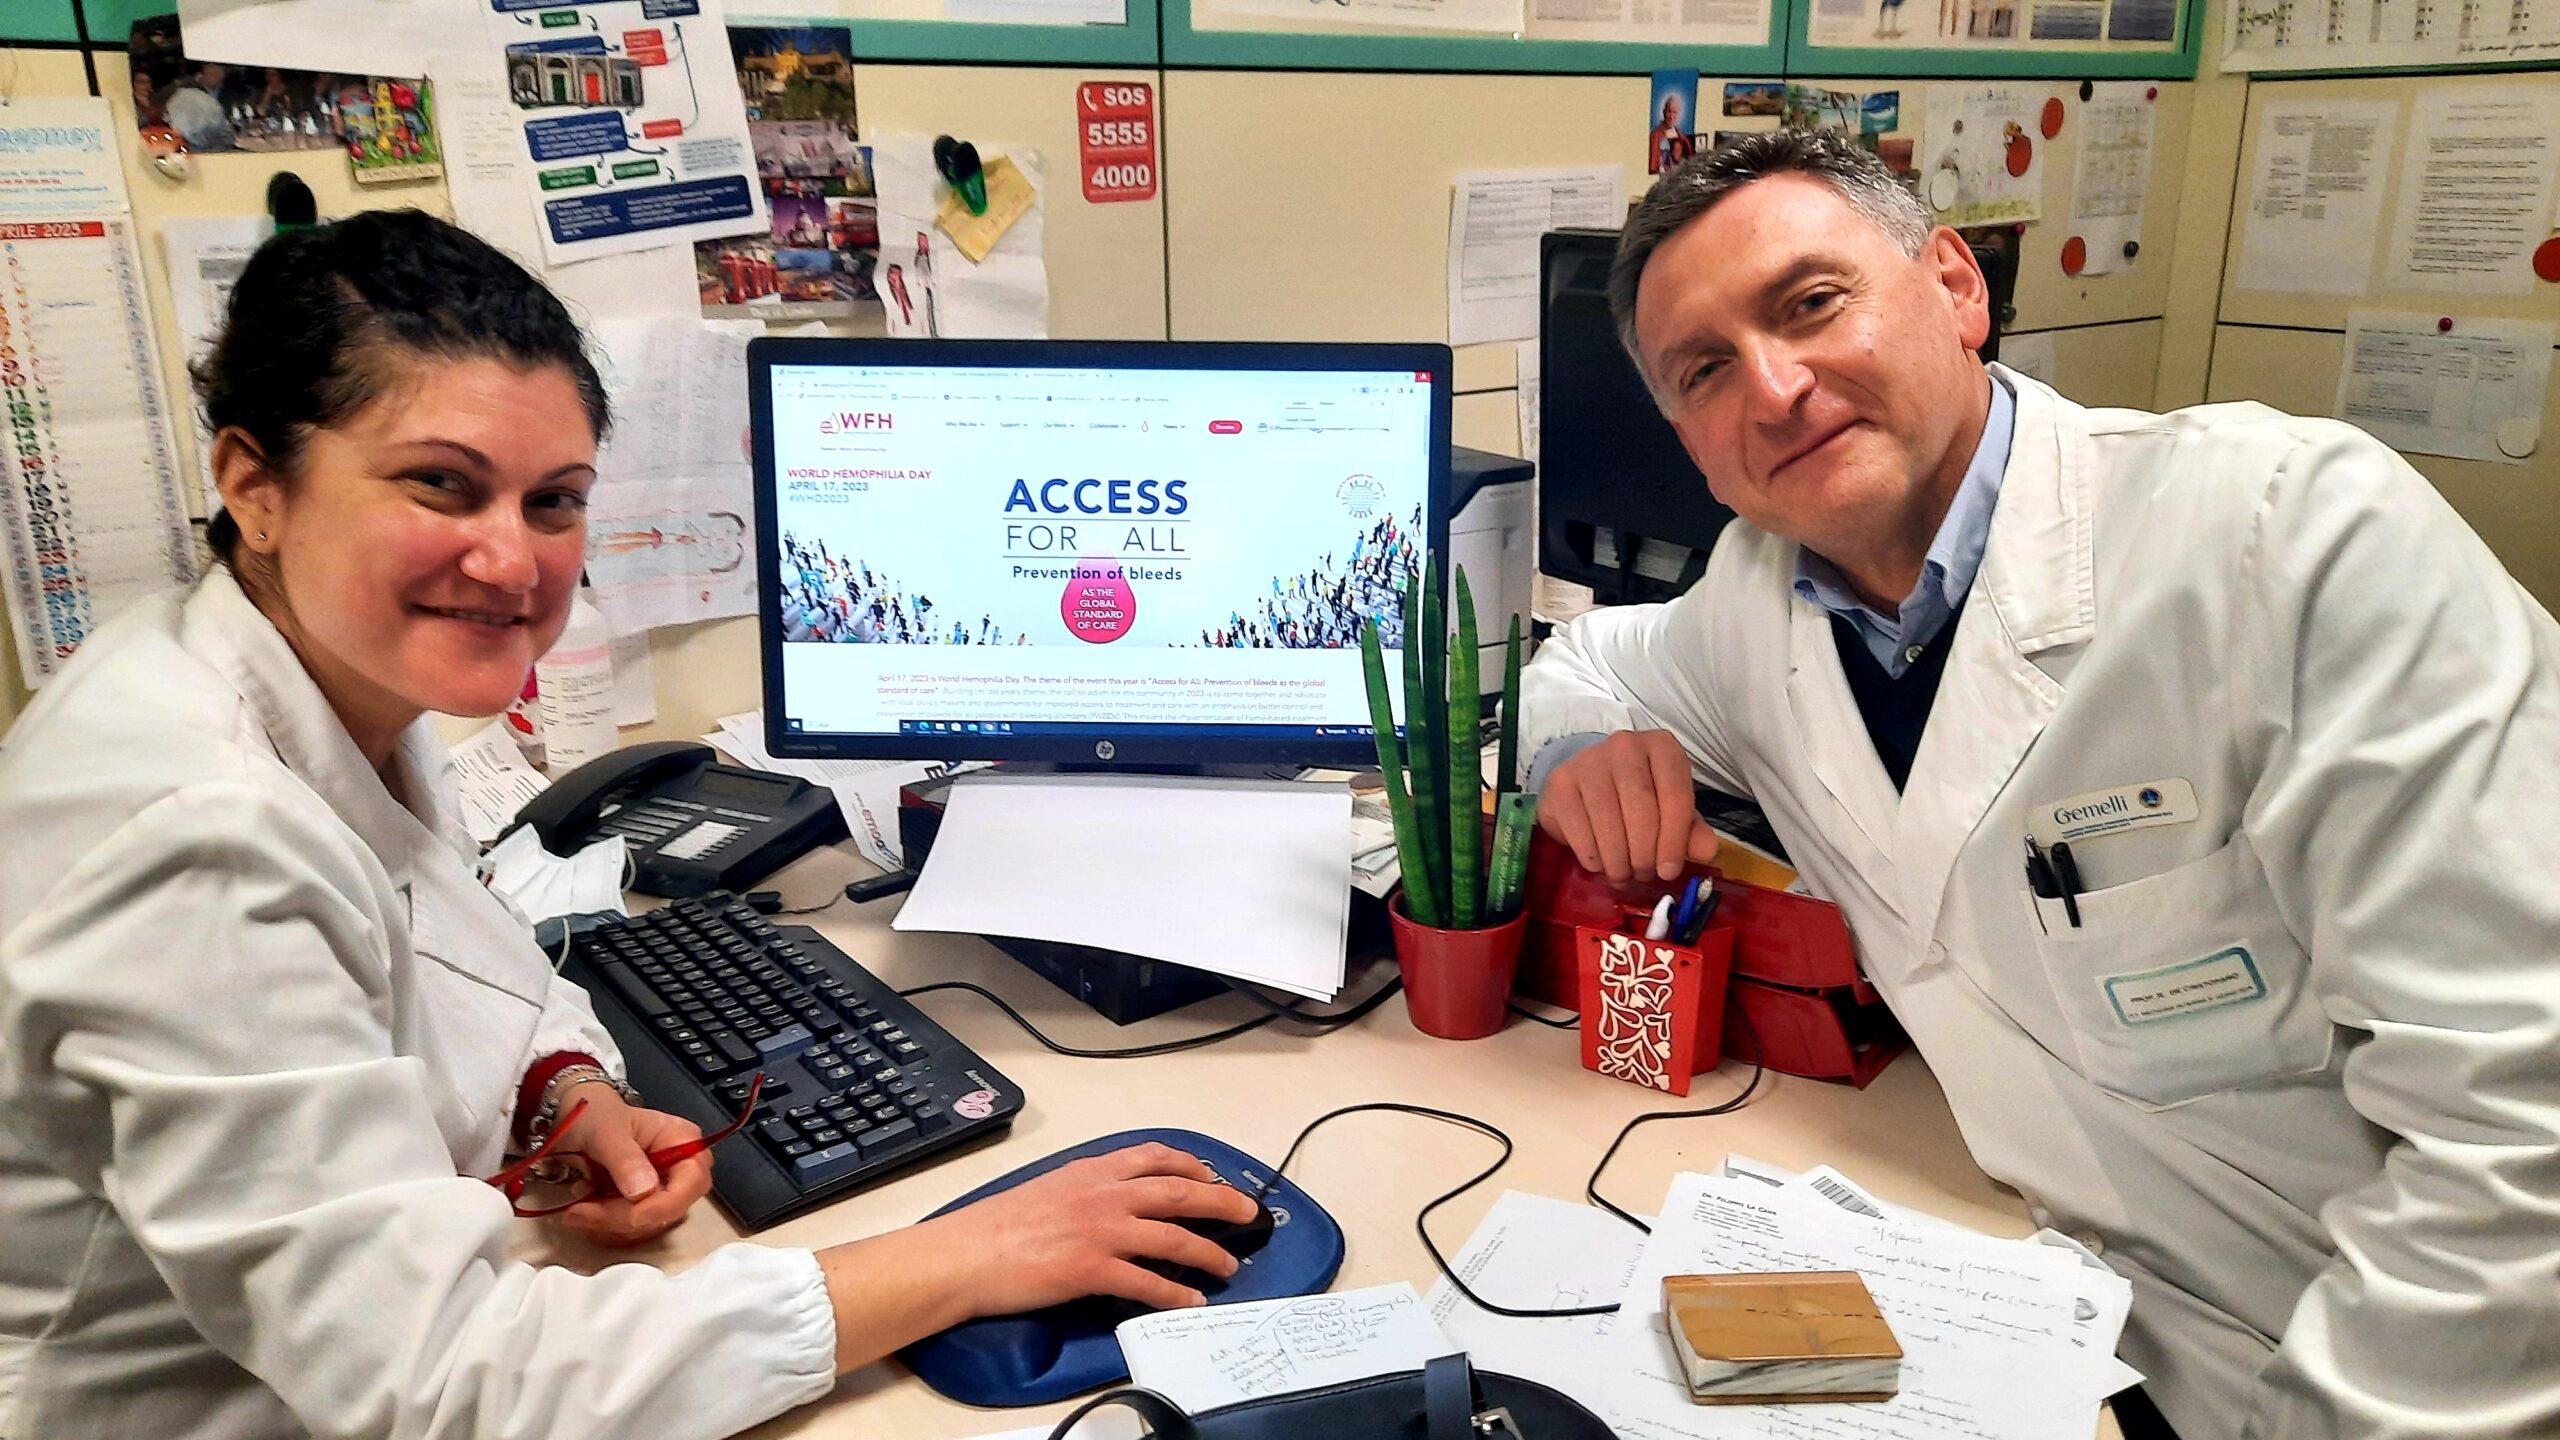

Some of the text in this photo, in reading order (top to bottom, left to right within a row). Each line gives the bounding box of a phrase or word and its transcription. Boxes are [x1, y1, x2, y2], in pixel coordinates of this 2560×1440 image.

[1103, 87, 1147, 106] SOS
[1087, 121, 1148, 146] 5555
[1091, 164, 1151, 188] 4000
[840, 412, 893, 429] WFH
[788, 469, 932, 479] WORLD HEMOPHILIA DAY
[788, 481, 820, 491] APRIL
[842, 482, 869, 491] 2023
[1004, 478, 1188, 515] ACCESS
[1007, 525, 1185, 552] FOR ALL
[1013, 565, 1182, 580] Prevention of bleeds
[1081, 588, 1115, 597] AS THE
[1079, 599, 1117, 608] GLOBAL
[1073, 610, 1124, 619] STANDARD
[1077, 621, 1117, 630] OF CARE
[2054, 795, 2128, 825] Gemelli
